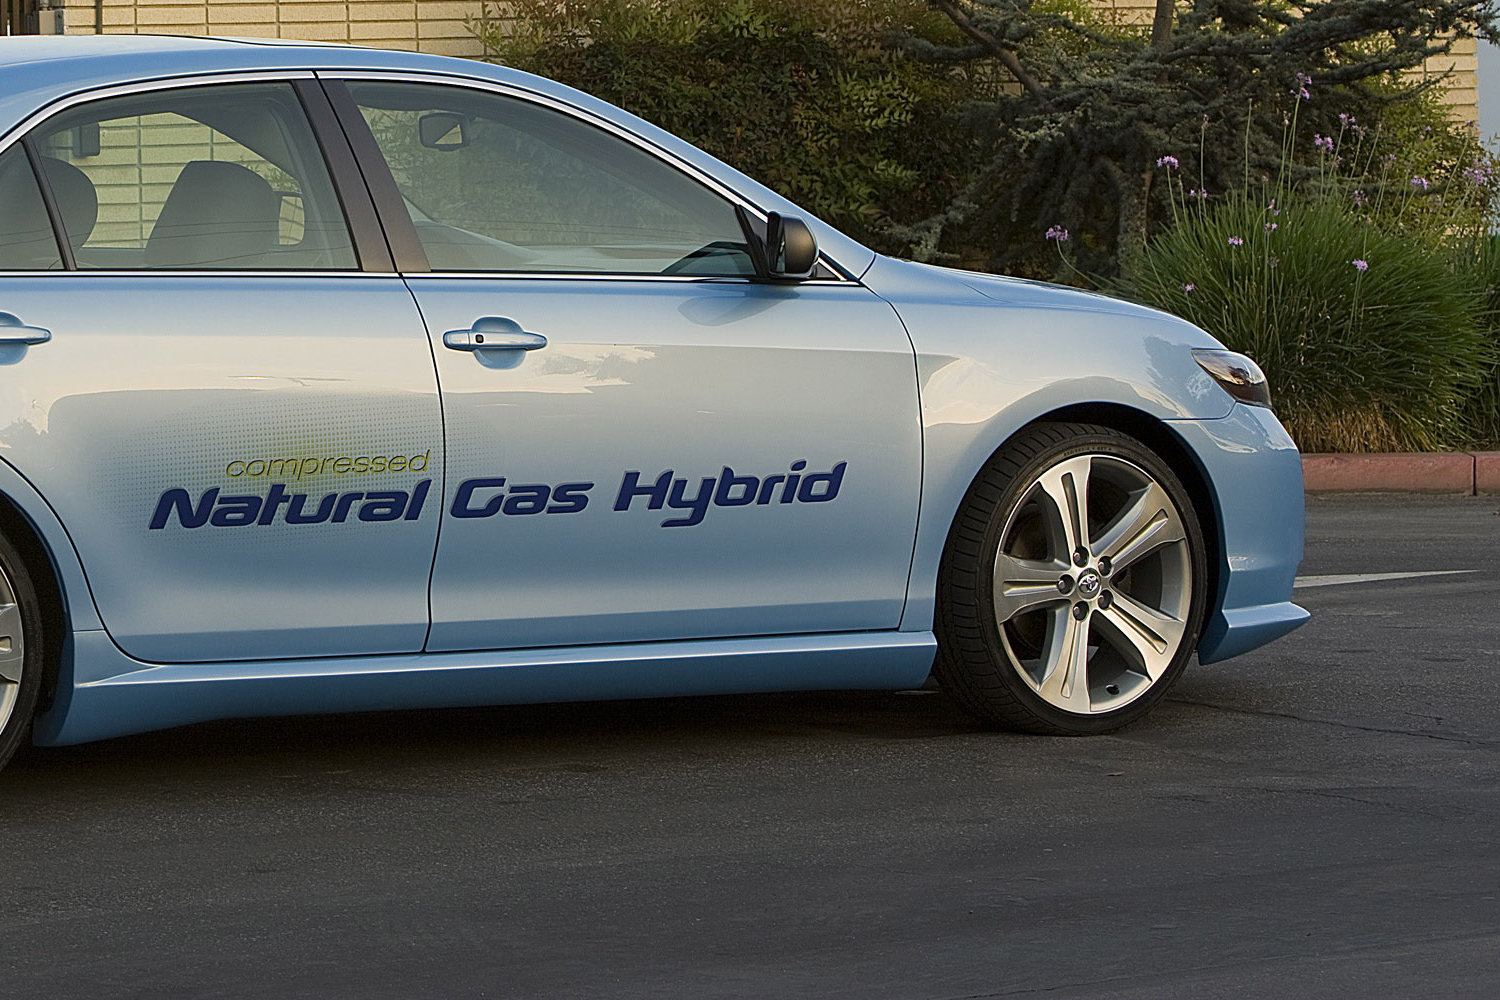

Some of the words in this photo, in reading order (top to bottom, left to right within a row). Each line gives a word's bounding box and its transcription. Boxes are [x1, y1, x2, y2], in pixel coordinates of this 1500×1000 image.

[225, 449, 431, 481] compressed
[148, 478, 432, 530] Natural
[449, 475, 595, 519] Gas
[612, 458, 848, 529] Hybrid
